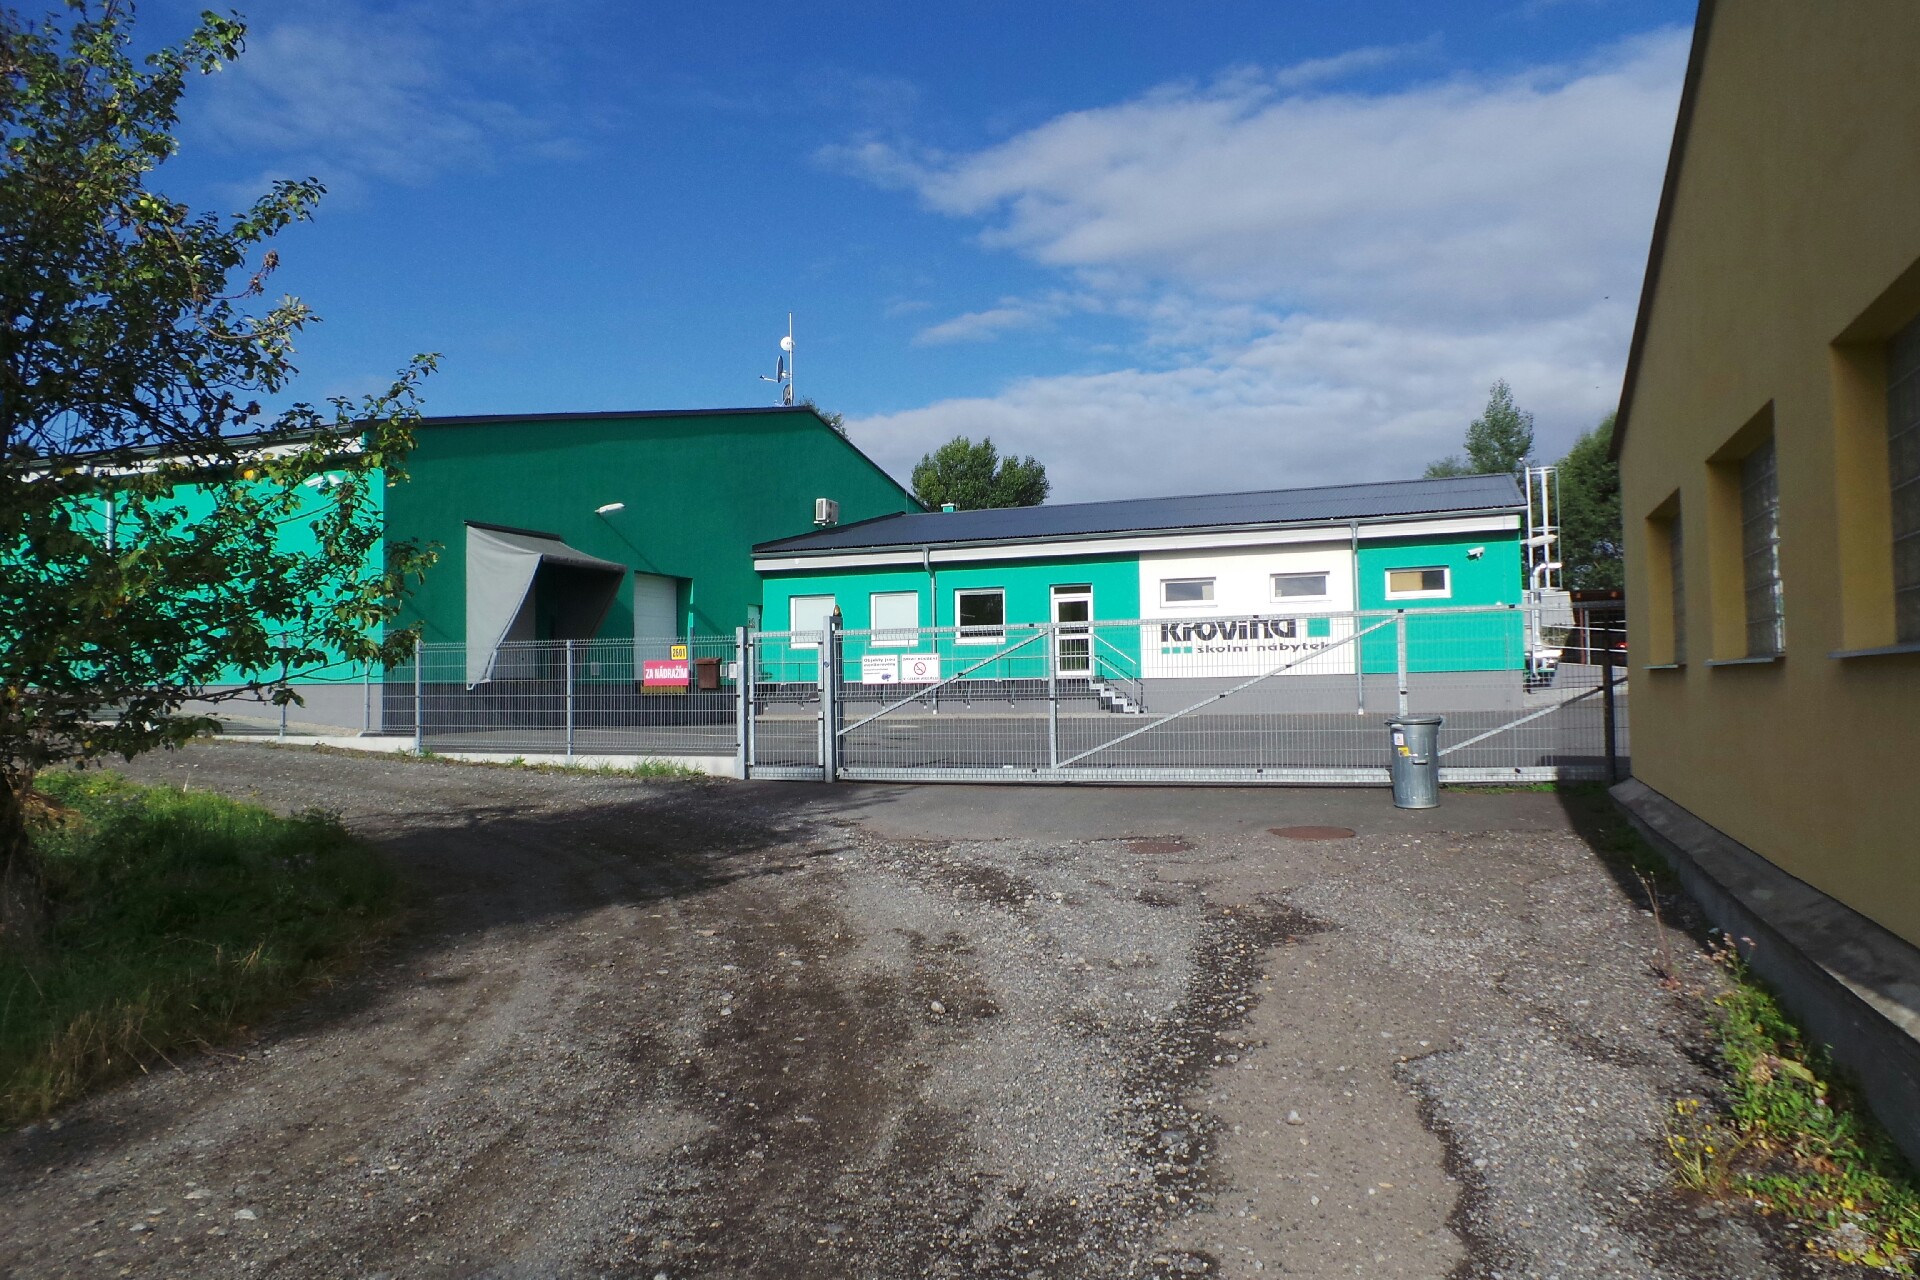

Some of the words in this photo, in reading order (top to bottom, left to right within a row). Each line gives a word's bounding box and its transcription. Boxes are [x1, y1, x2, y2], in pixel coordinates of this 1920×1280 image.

[672, 648, 686, 658] 2601
[646, 668, 654, 678] ZA
[655, 666, 688, 678] NÁDRAŽÍM
